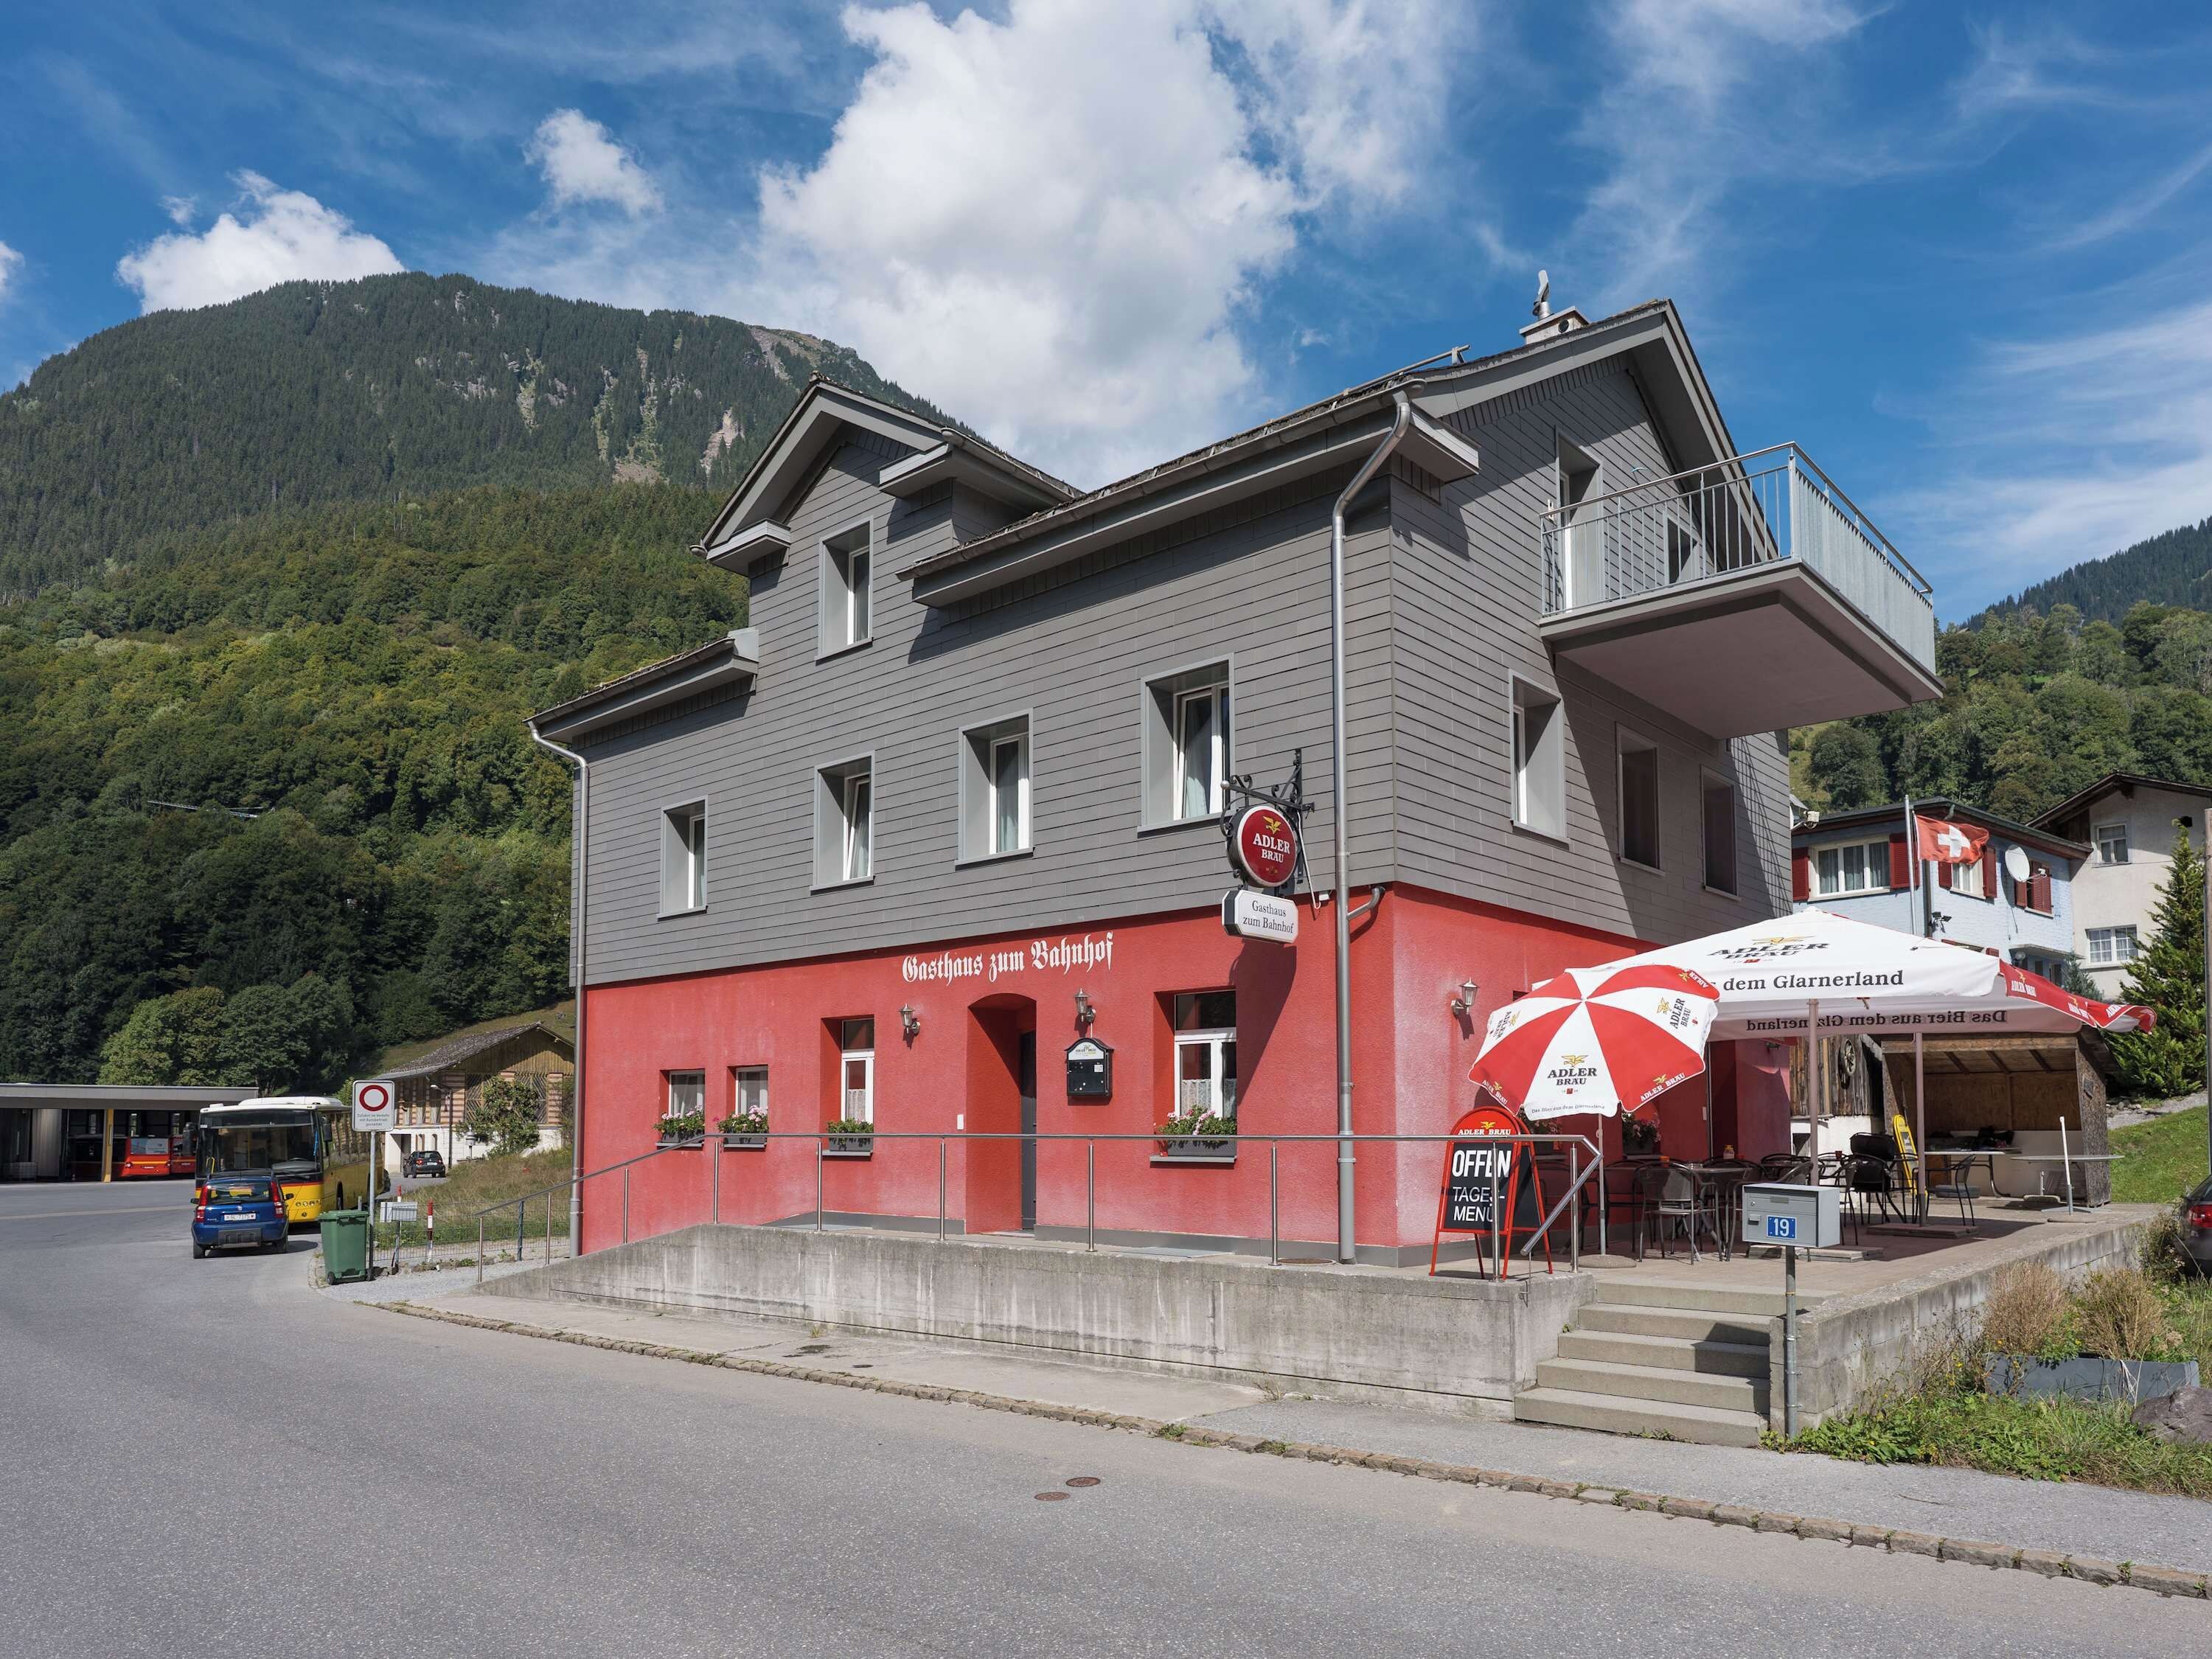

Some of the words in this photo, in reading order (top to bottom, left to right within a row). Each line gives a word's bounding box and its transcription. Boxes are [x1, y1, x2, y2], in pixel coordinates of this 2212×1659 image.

[1253, 832, 1290, 854] ADLER
[1252, 900, 1287, 917] Gasthaus
[1243, 917, 1260, 927] zum
[1263, 917, 1294, 933] Bahnhof
[1707, 943, 1830, 956] ADLER
[902, 951, 983, 987] Gasthaus
[988, 950, 1025, 983] zum
[1031, 932, 1113, 975] Bahnhof
[1723, 977, 1767, 991] dem
[1773, 969, 1904, 989] Glarnerland
[1669, 998, 1686, 1029] ADLER
[1548, 1068, 1597, 1078] ADLER
[1640, 1085, 1663, 1102] ADLER
[1773, 1217, 1790, 1237] 19
